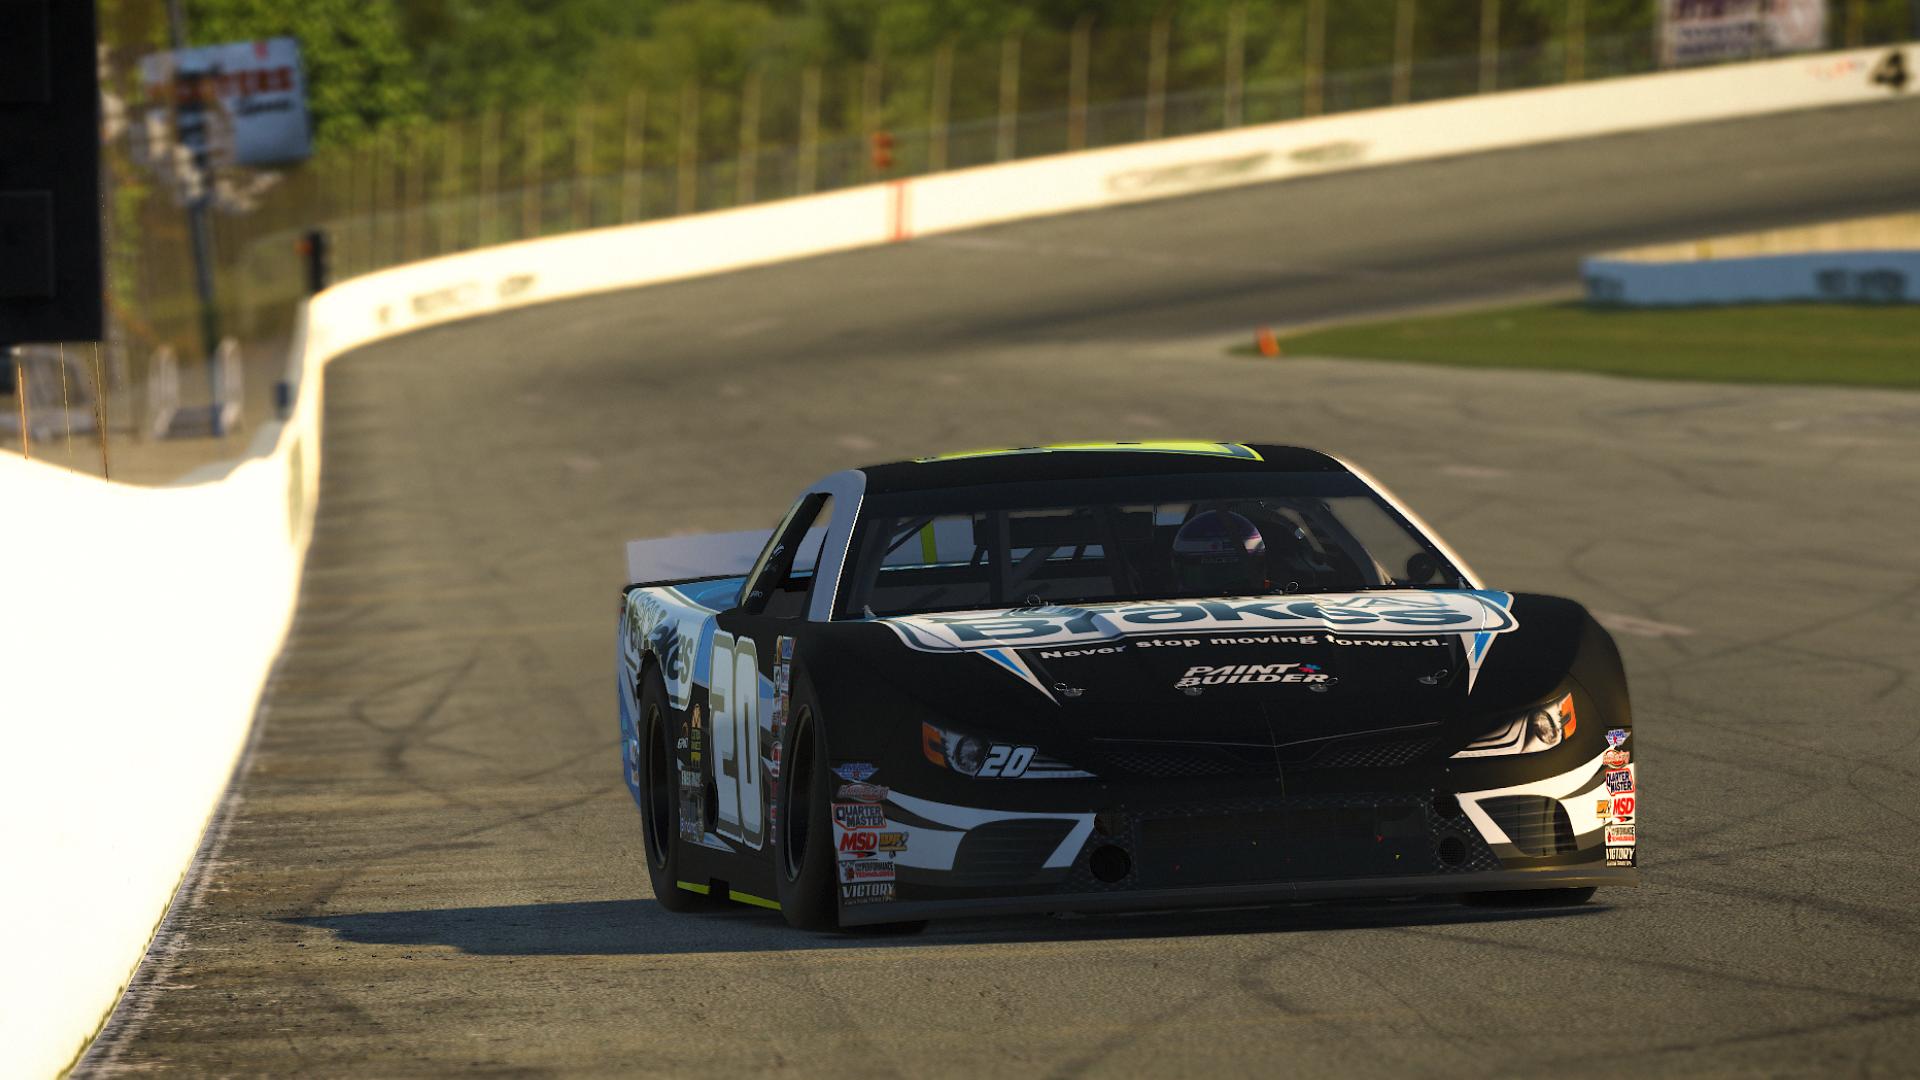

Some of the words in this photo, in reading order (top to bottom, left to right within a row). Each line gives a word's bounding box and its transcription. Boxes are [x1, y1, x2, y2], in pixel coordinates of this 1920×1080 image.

[1872, 48, 1909, 91] 4
[945, 601, 1473, 641] Brakes
[1039, 645, 1126, 660] Never
[1135, 637, 1200, 649] stop
[1209, 634, 1315, 647] moving
[1187, 663, 1302, 676] PAINT
[1177, 673, 1330, 688] BUILDER
[709, 629, 765, 852] 20
[975, 744, 1039, 779] 20
[836, 805, 881, 821] QUARTER
[1613, 797, 1635, 816] MSD
[847, 815, 885, 828] MASTER
[839, 831, 878, 852] MSD
[1606, 848, 1635, 861] VICTORY
[842, 882, 895, 899] VICTORY
